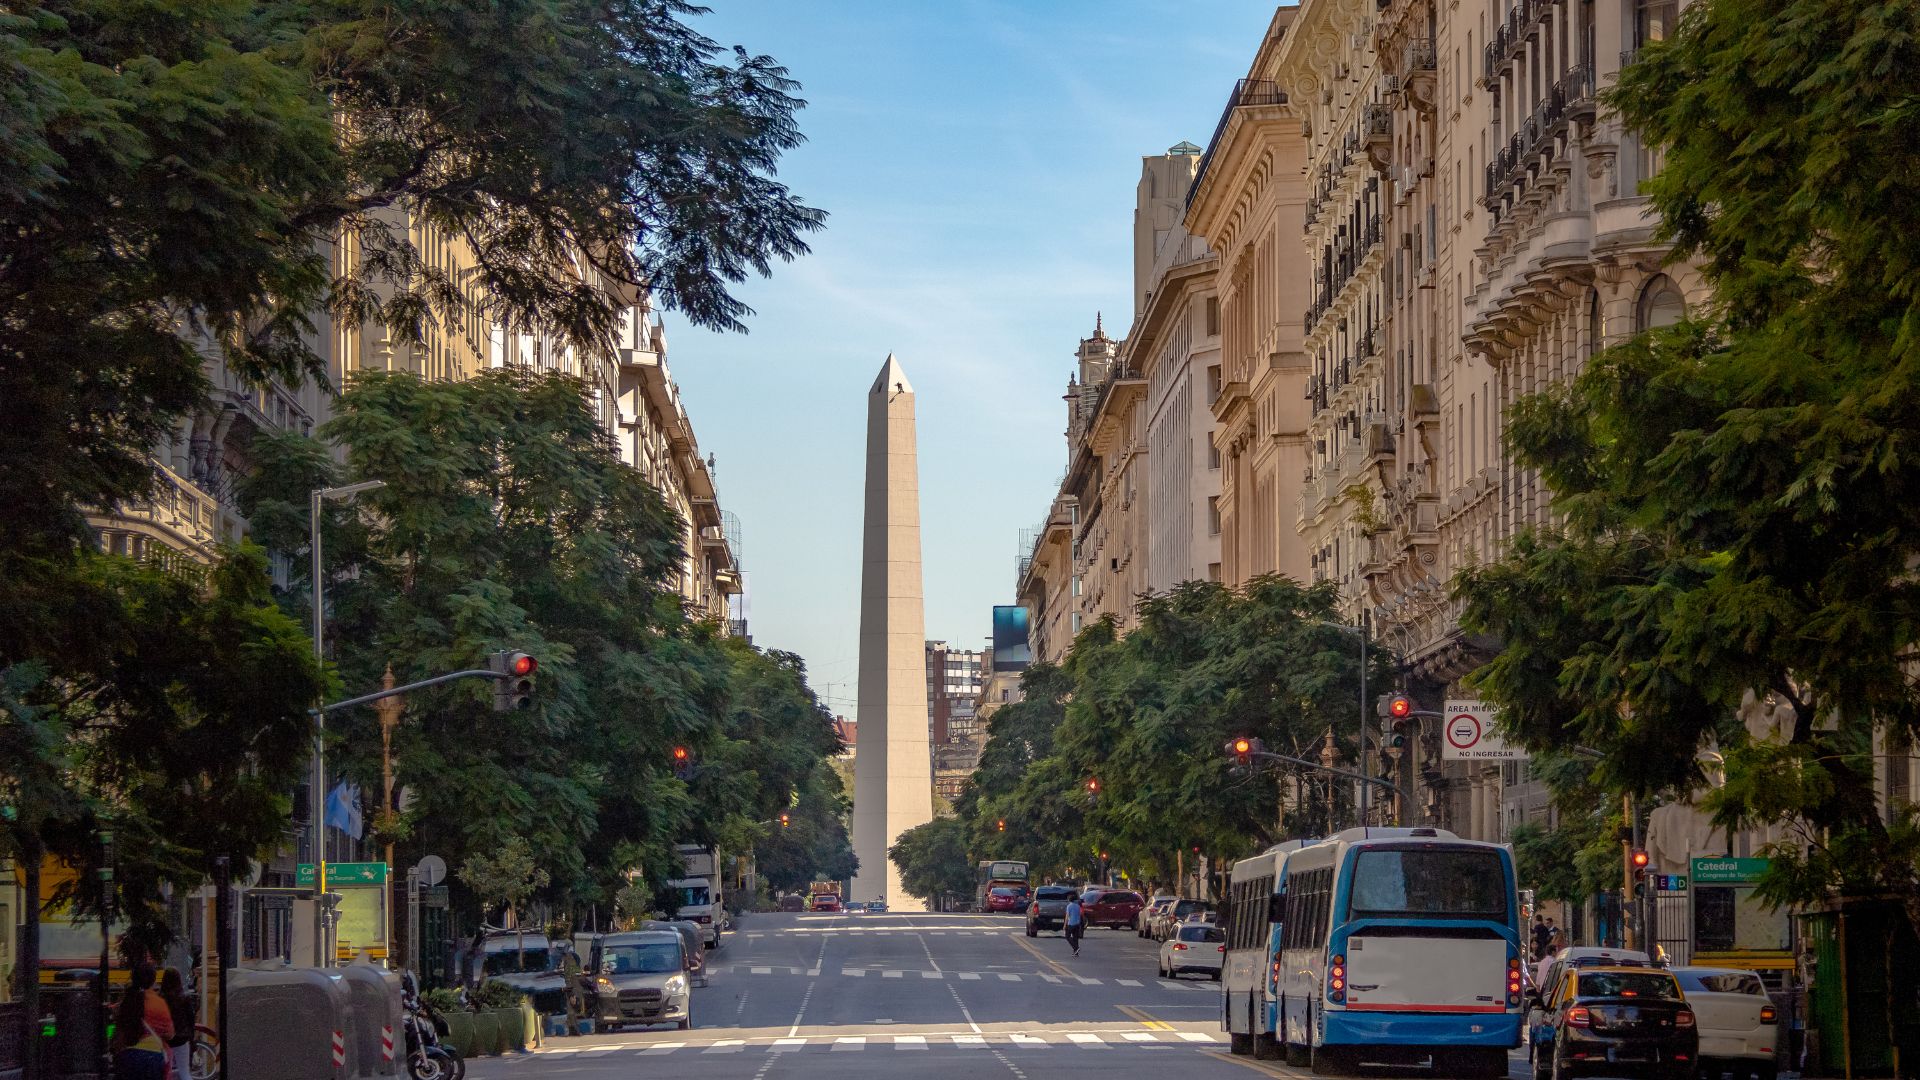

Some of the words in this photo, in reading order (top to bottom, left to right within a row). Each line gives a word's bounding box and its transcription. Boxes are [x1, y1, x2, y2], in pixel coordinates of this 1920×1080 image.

[1697, 862, 1738, 871] Catedral
[1660, 878, 1666, 887] E
[1668, 879, 1676, 887] A
[1678, 879, 1686, 888] D
